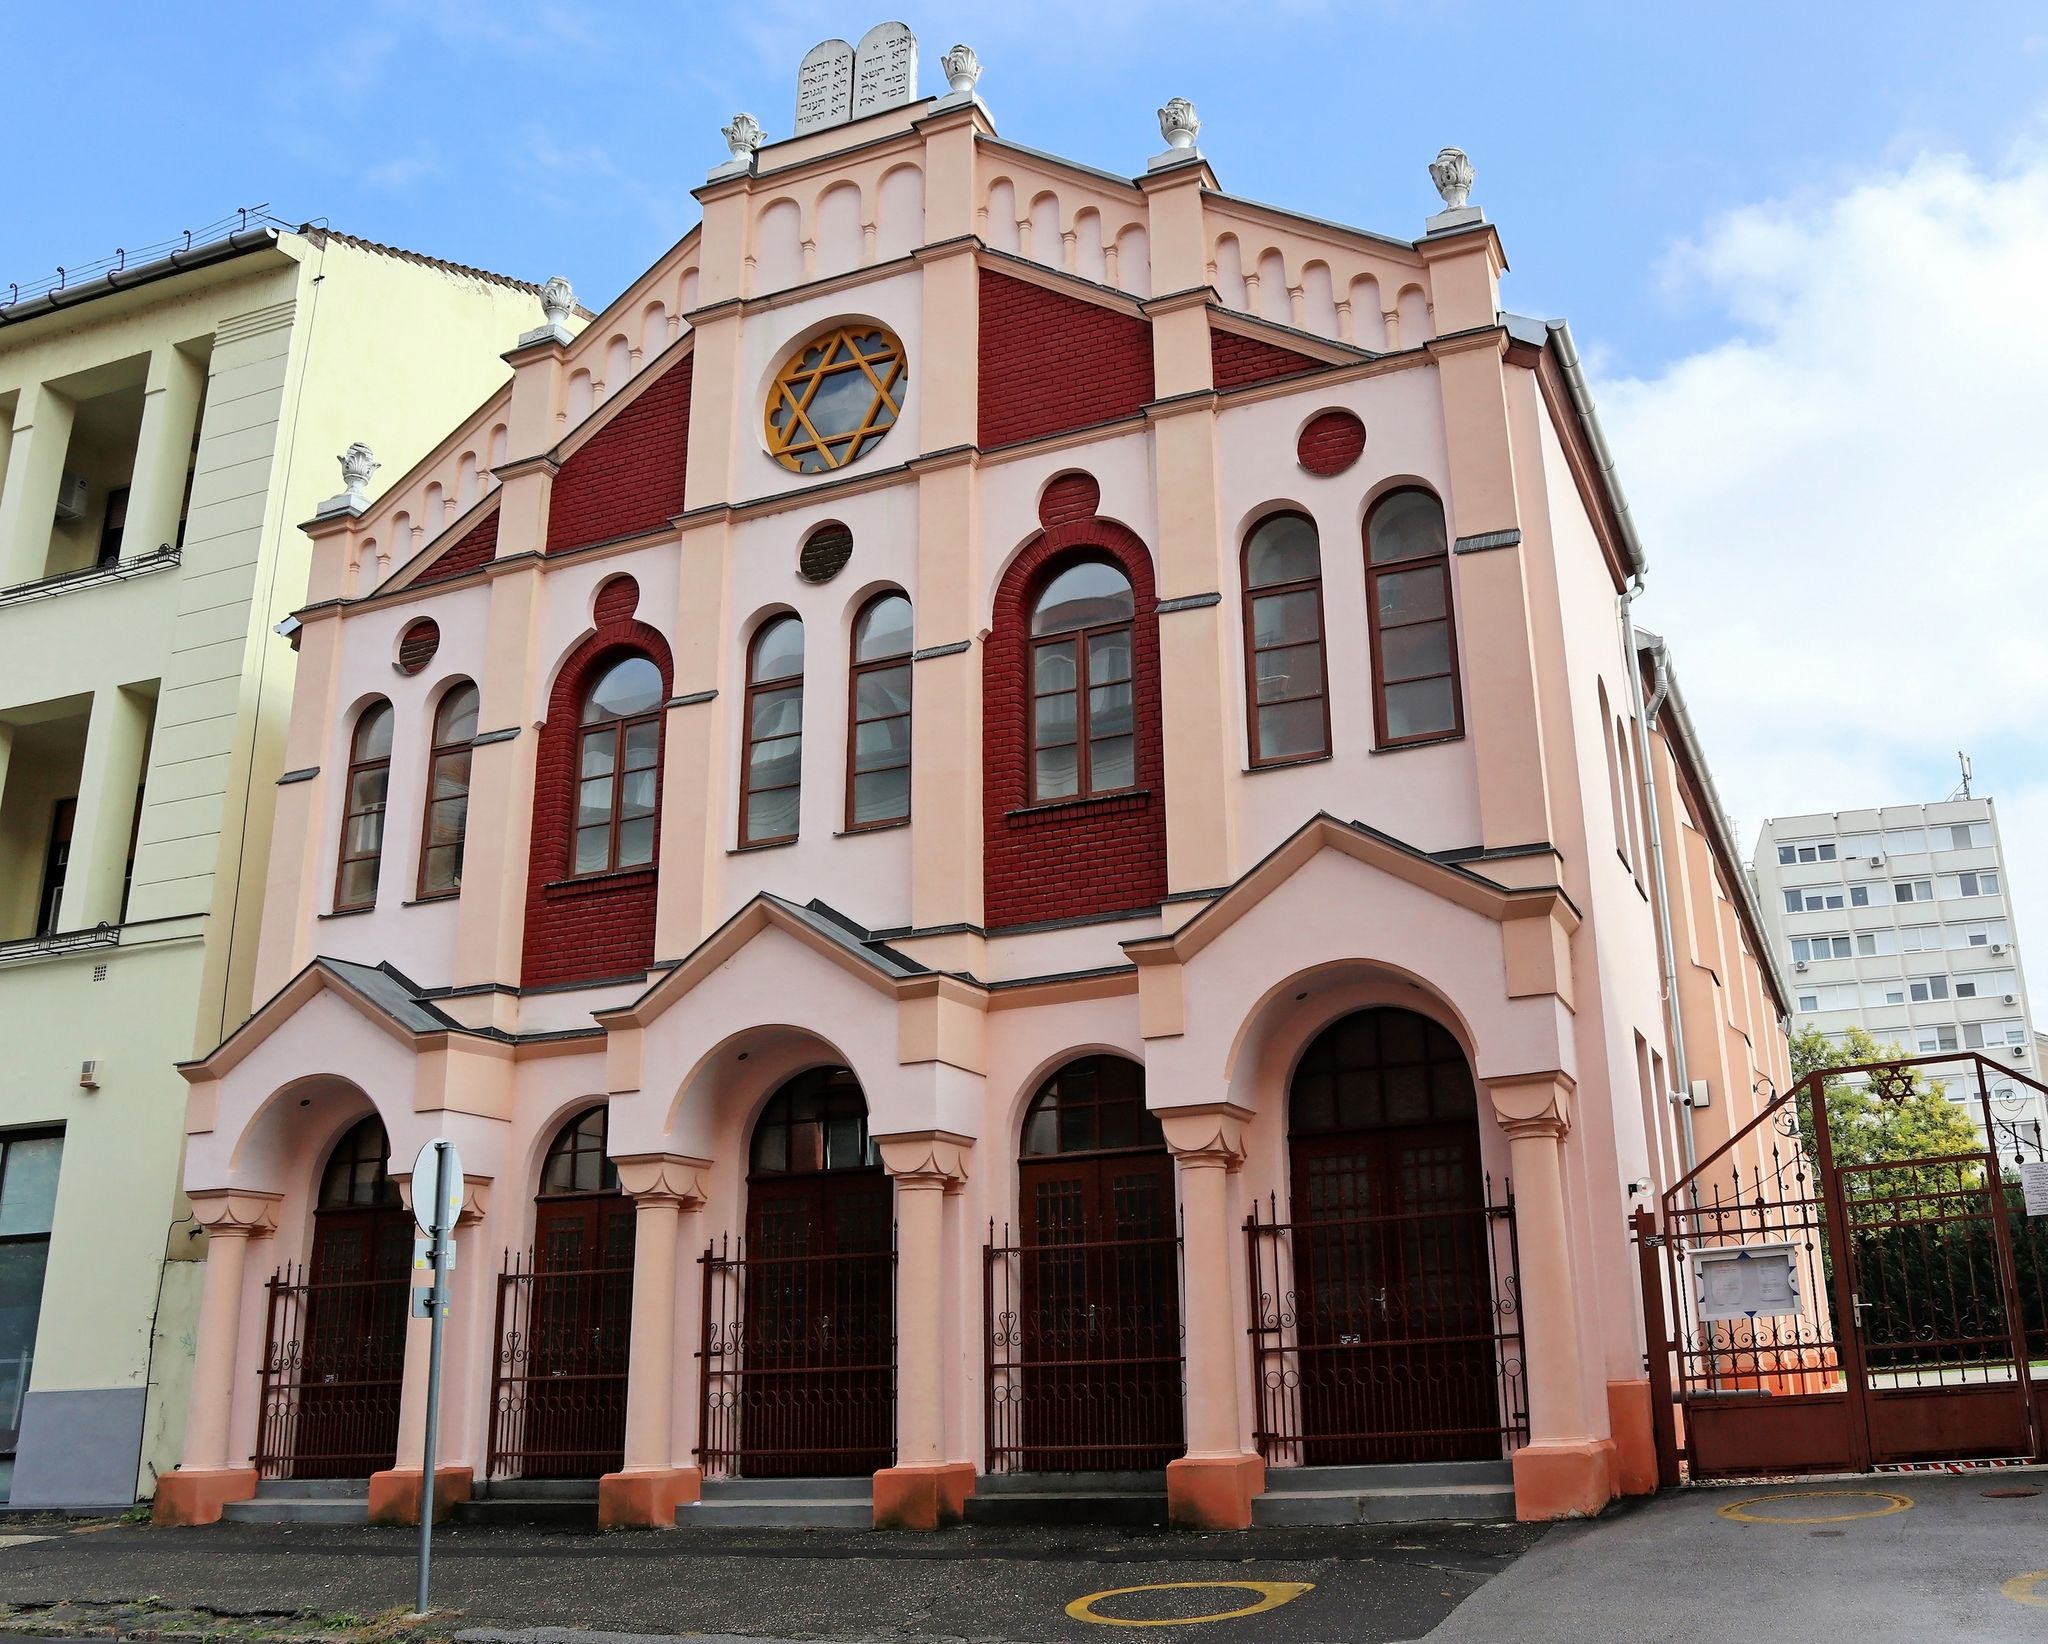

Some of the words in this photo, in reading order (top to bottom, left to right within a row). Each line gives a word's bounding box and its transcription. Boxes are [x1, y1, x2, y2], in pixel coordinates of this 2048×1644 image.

[834, 52, 848, 65] לא
[892, 46, 907, 59] לא
[802, 61, 830, 75] תרצח
[864, 55, 886, 68] יהיה
[891, 58, 907, 72] לא
[834, 64, 848, 77] לא
[861, 67, 885, 81] תשא
[832, 77, 847, 90] לא
[884, 73, 906, 84] זכור
[861, 82, 877, 94] את
[831, 89, 846, 103] לא
[860, 95, 875, 106] את
[831, 103, 846, 116] לא
